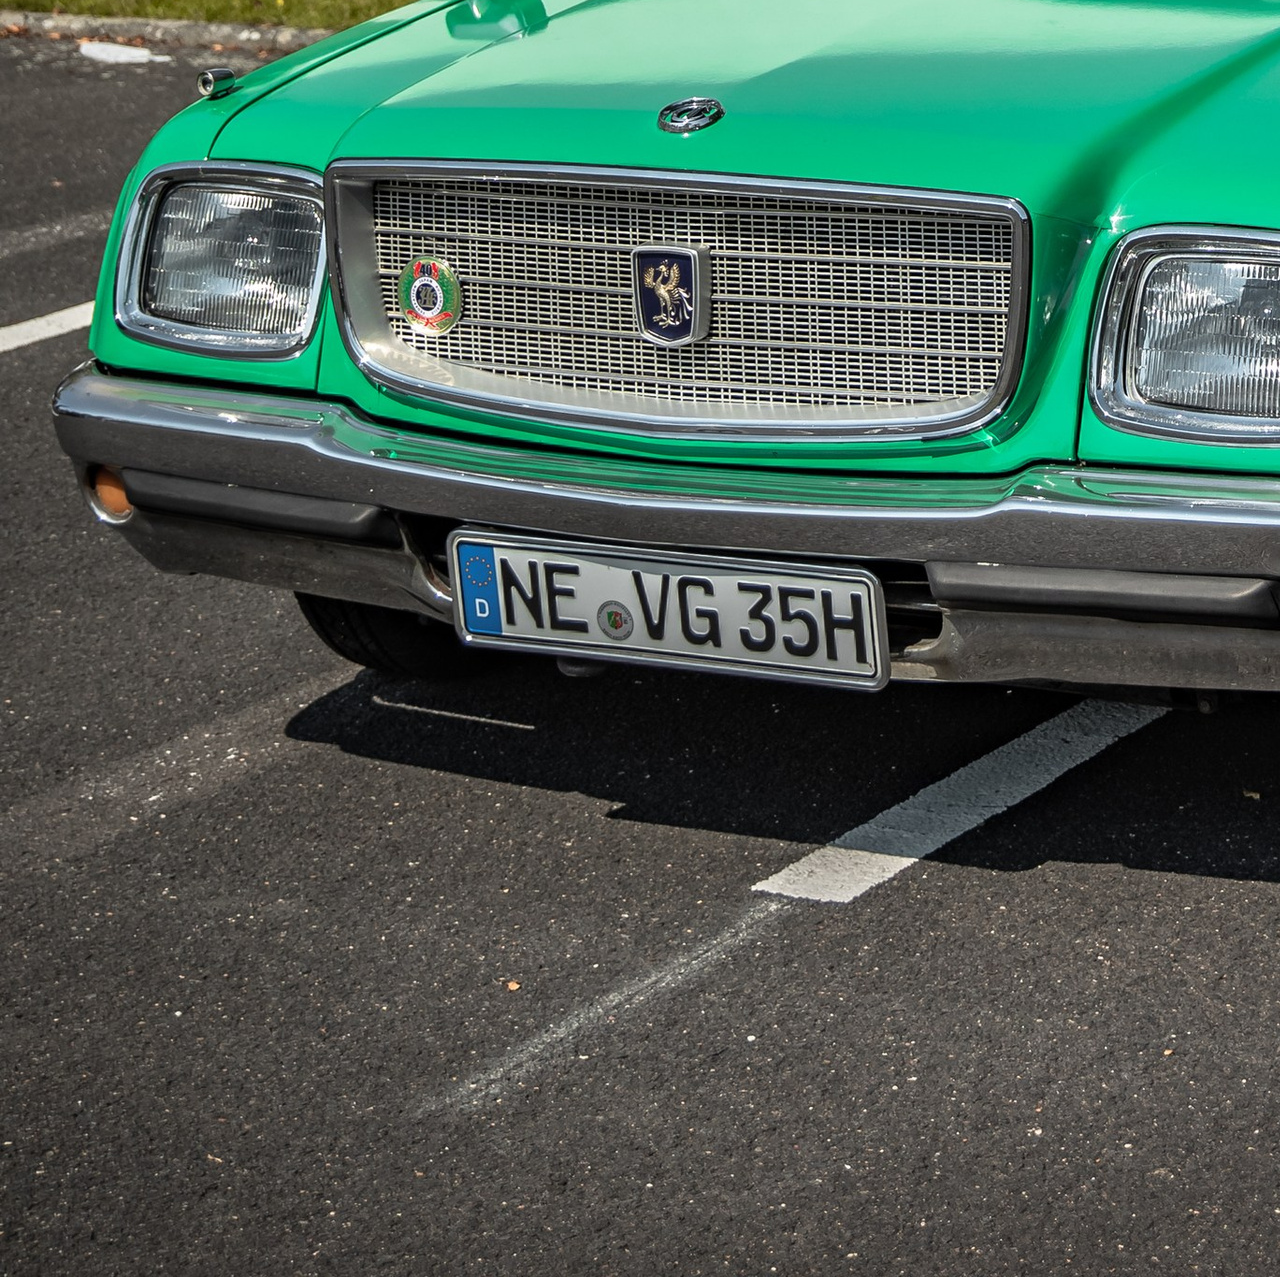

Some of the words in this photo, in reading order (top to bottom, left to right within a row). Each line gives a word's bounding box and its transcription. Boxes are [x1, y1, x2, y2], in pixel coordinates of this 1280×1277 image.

[420, 263, 432, 276] 40
[475, 598, 489, 617] D
[499, 557, 589, 634] NE
[632, 570, 722, 648] VG
[737, 581, 868, 664] 35H
